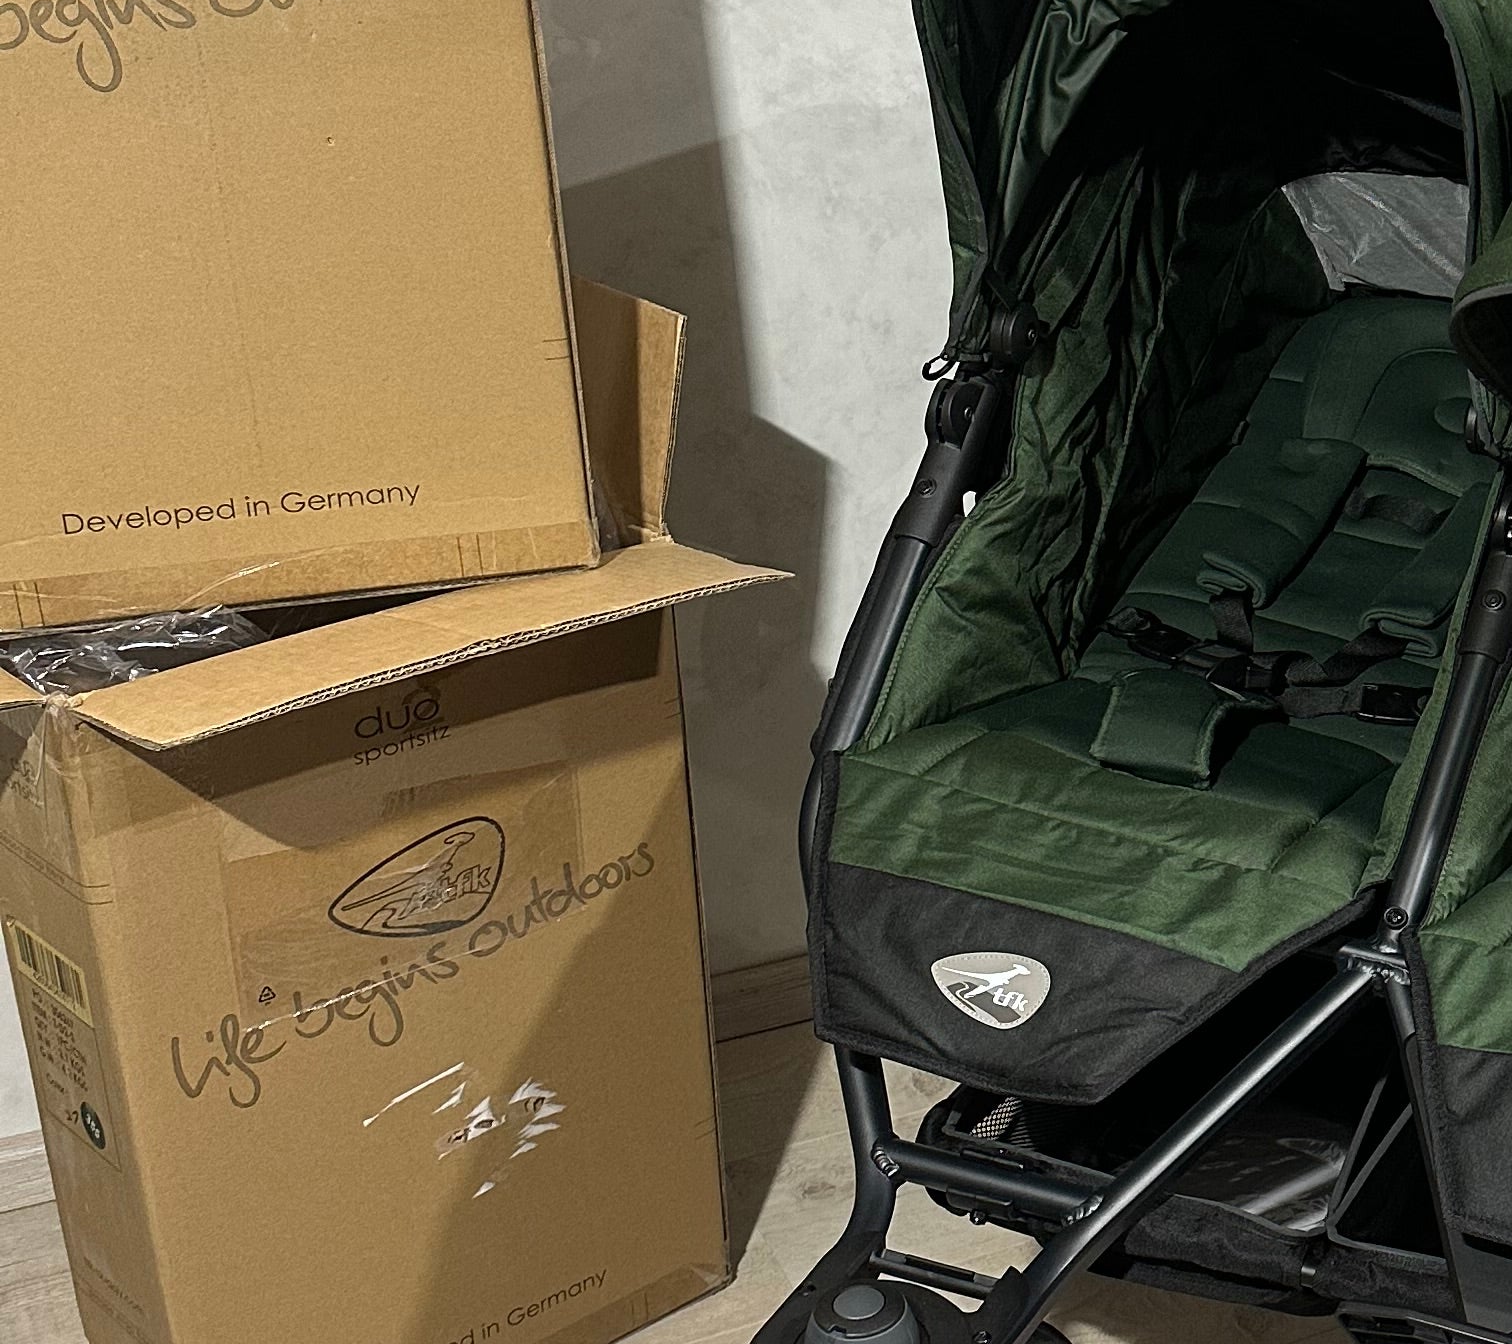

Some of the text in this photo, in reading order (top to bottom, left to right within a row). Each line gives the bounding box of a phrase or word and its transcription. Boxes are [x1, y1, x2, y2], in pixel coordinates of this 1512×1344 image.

[61, 484, 420, 535] Developed in Germany
[354, 698, 439, 739] duo
[353, 725, 451, 766] sportsitz
[992, 987, 1028, 1011] tfk
[171, 1013, 287, 1108] Life
[294, 940, 460, 1048] begins
[481, 1321, 500, 1340] in
[507, 1269, 608, 1326] Germany
